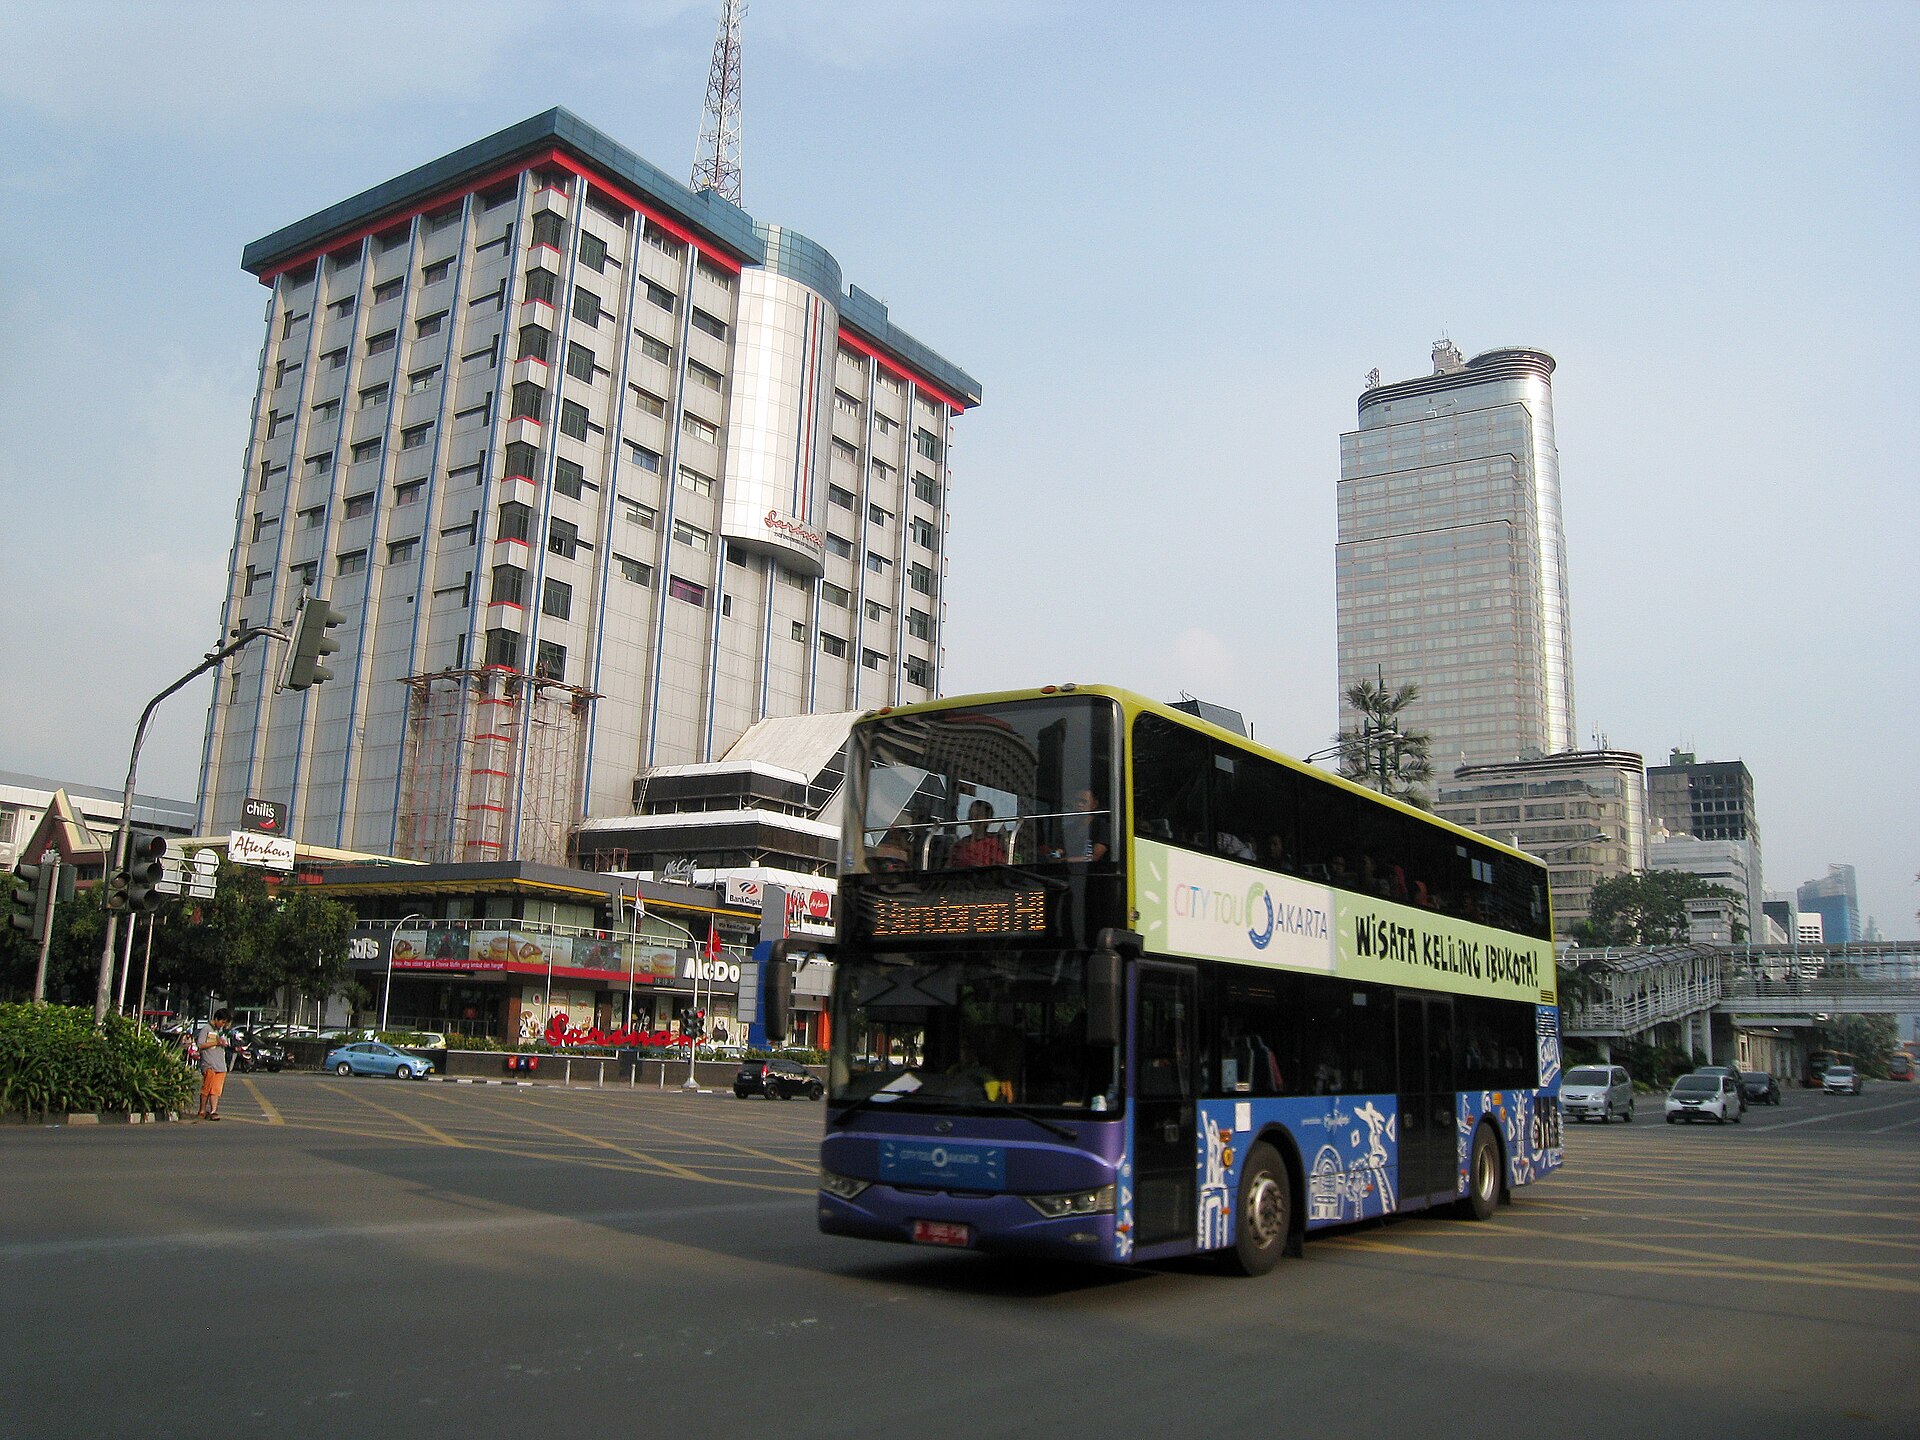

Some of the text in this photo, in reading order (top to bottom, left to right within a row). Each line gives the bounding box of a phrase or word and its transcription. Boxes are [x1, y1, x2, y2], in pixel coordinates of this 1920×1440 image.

[234, 835, 290, 858] Afterhour
[729, 894, 763, 907] BankCapit
[1174, 882, 1211, 921] CITY
